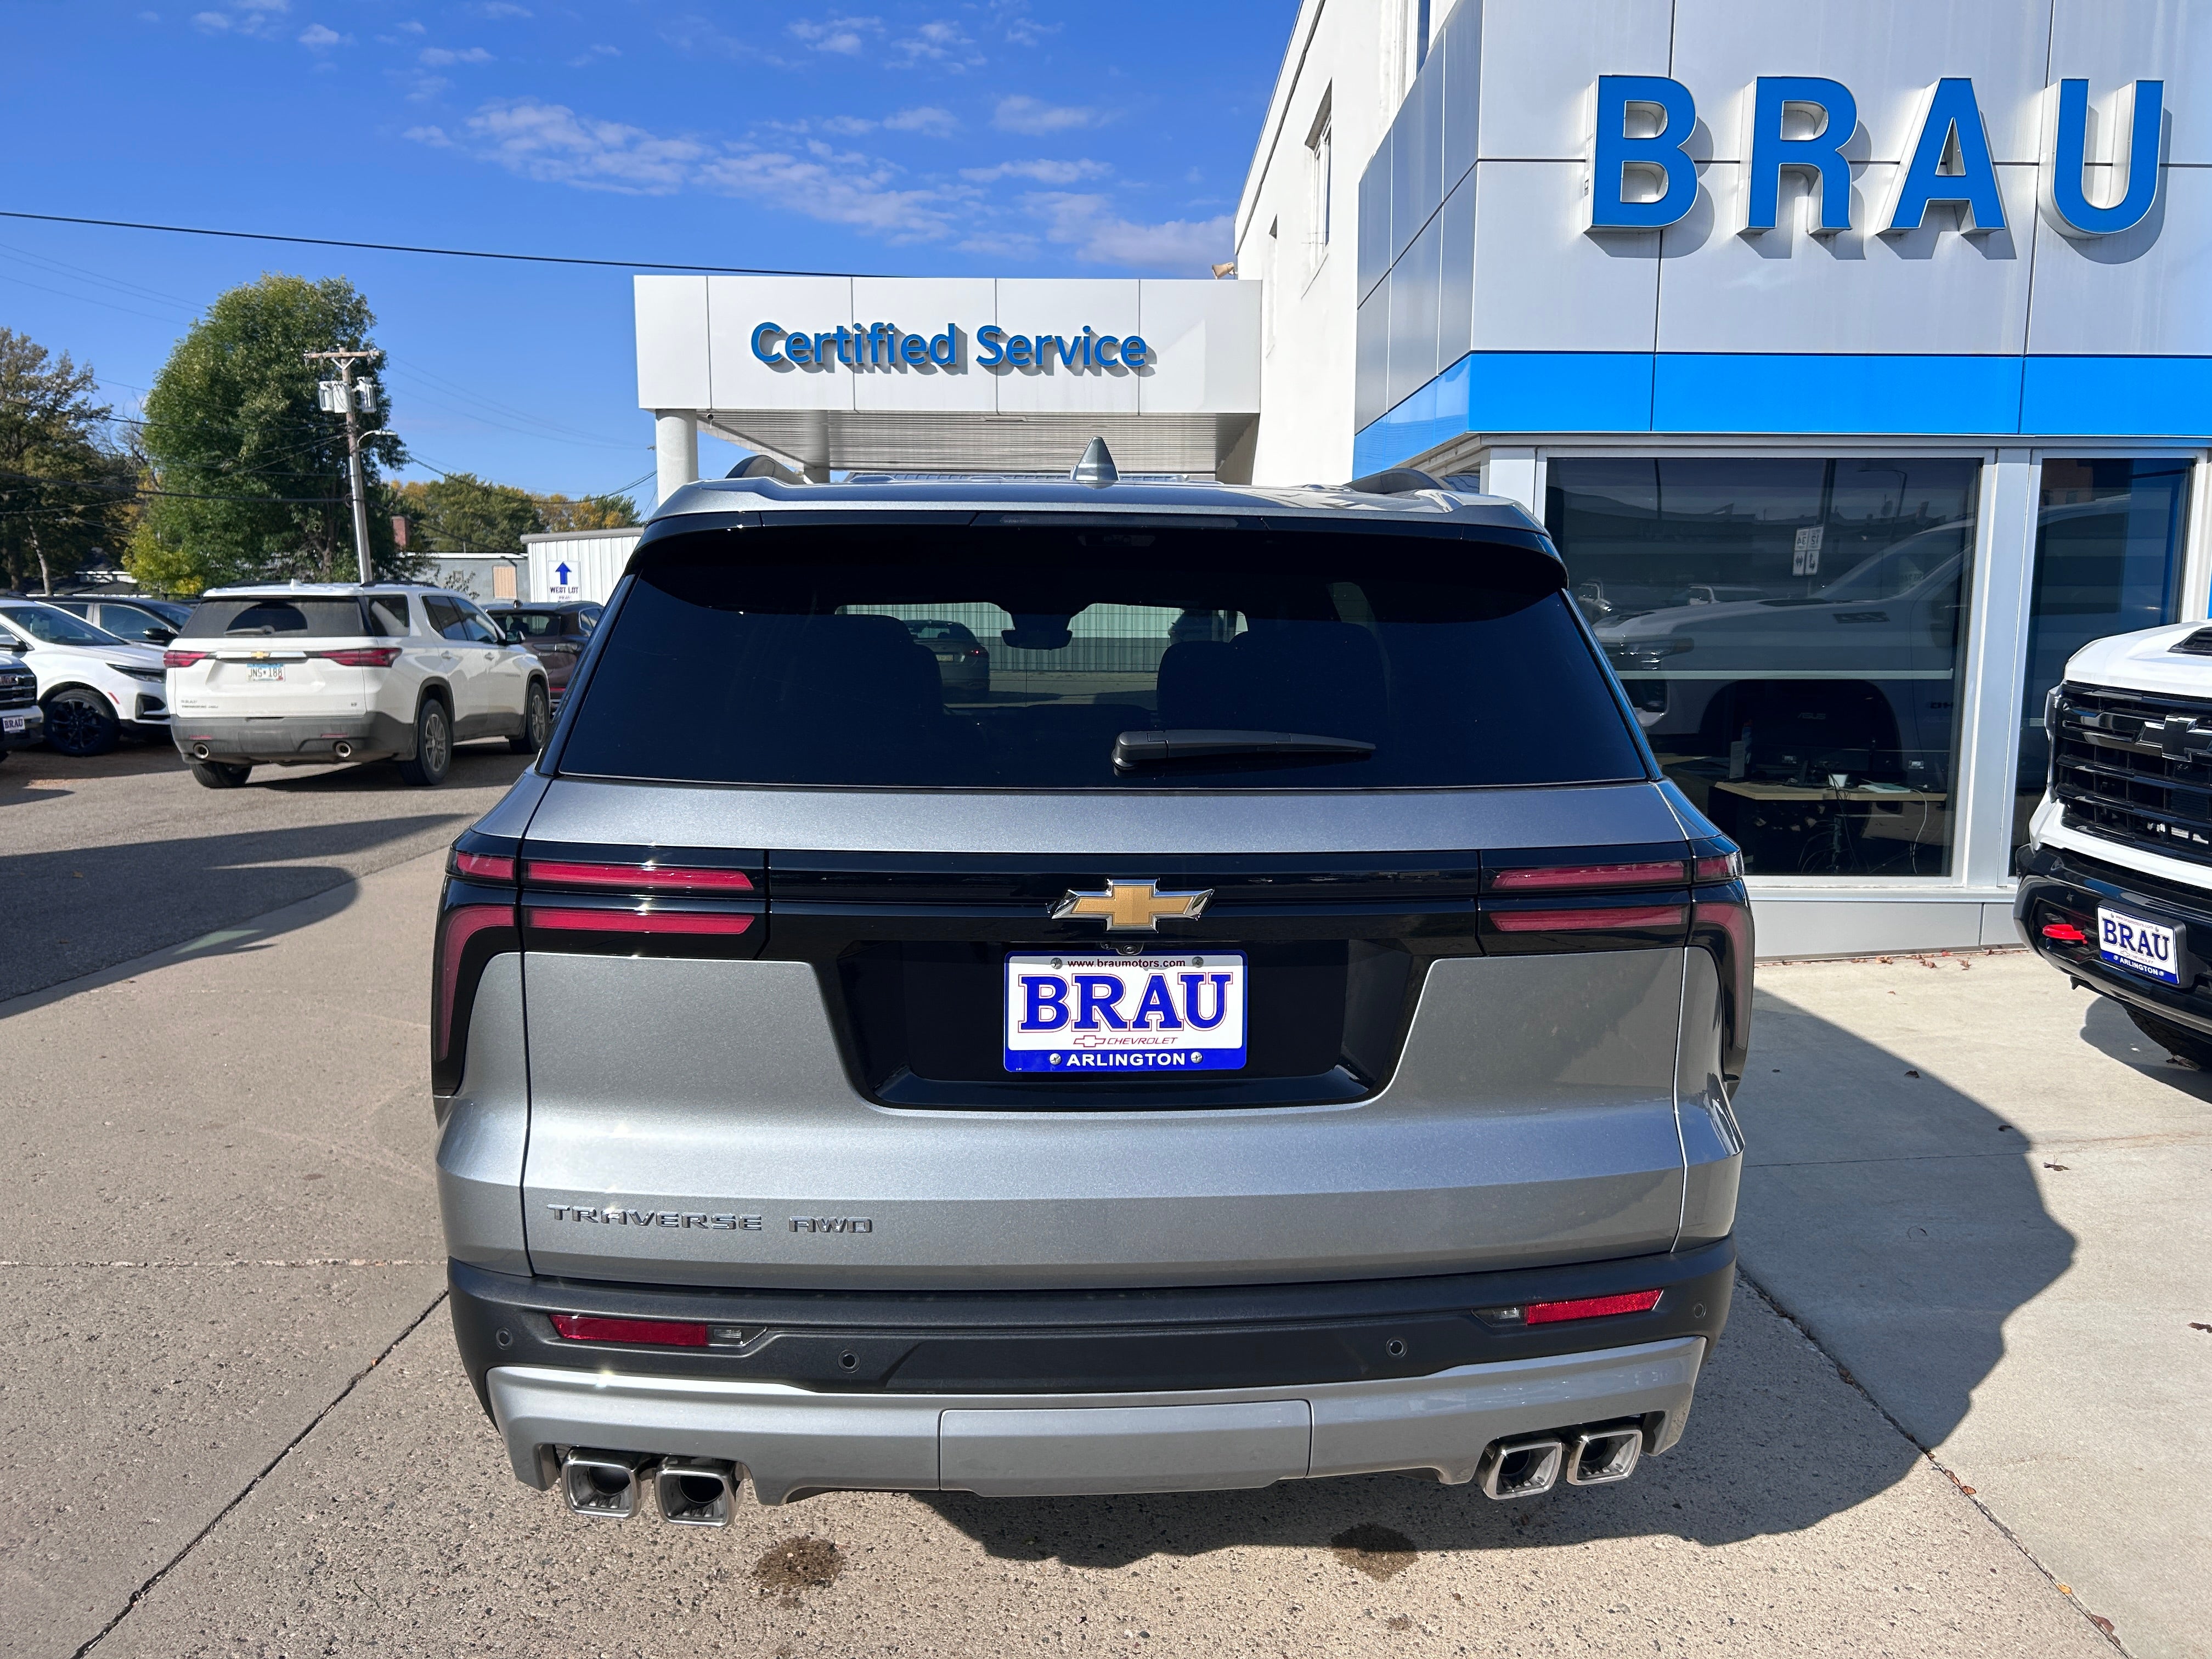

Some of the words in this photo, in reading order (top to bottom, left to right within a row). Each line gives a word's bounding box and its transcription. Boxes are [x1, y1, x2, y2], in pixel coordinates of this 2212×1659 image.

[1587, 75, 2164, 234] BRAU
[751, 321, 956, 365] Certified
[975, 325, 1148, 368] Service
[4, 719, 23, 729] BRAU
[2101, 917, 2170, 962] BRAU
[1067, 958, 1186, 968] www.braumotors.com
[2119, 957, 2159, 976] ARLINGTON
[1018, 972, 1233, 1032] BRAU
[1107, 1036, 1178, 1045] CHEVROLET
[1066, 1052, 1186, 1066] ARLINGTON
[546, 1203, 763, 1232] TRAVERSE
[788, 1215, 874, 1233] AWD
